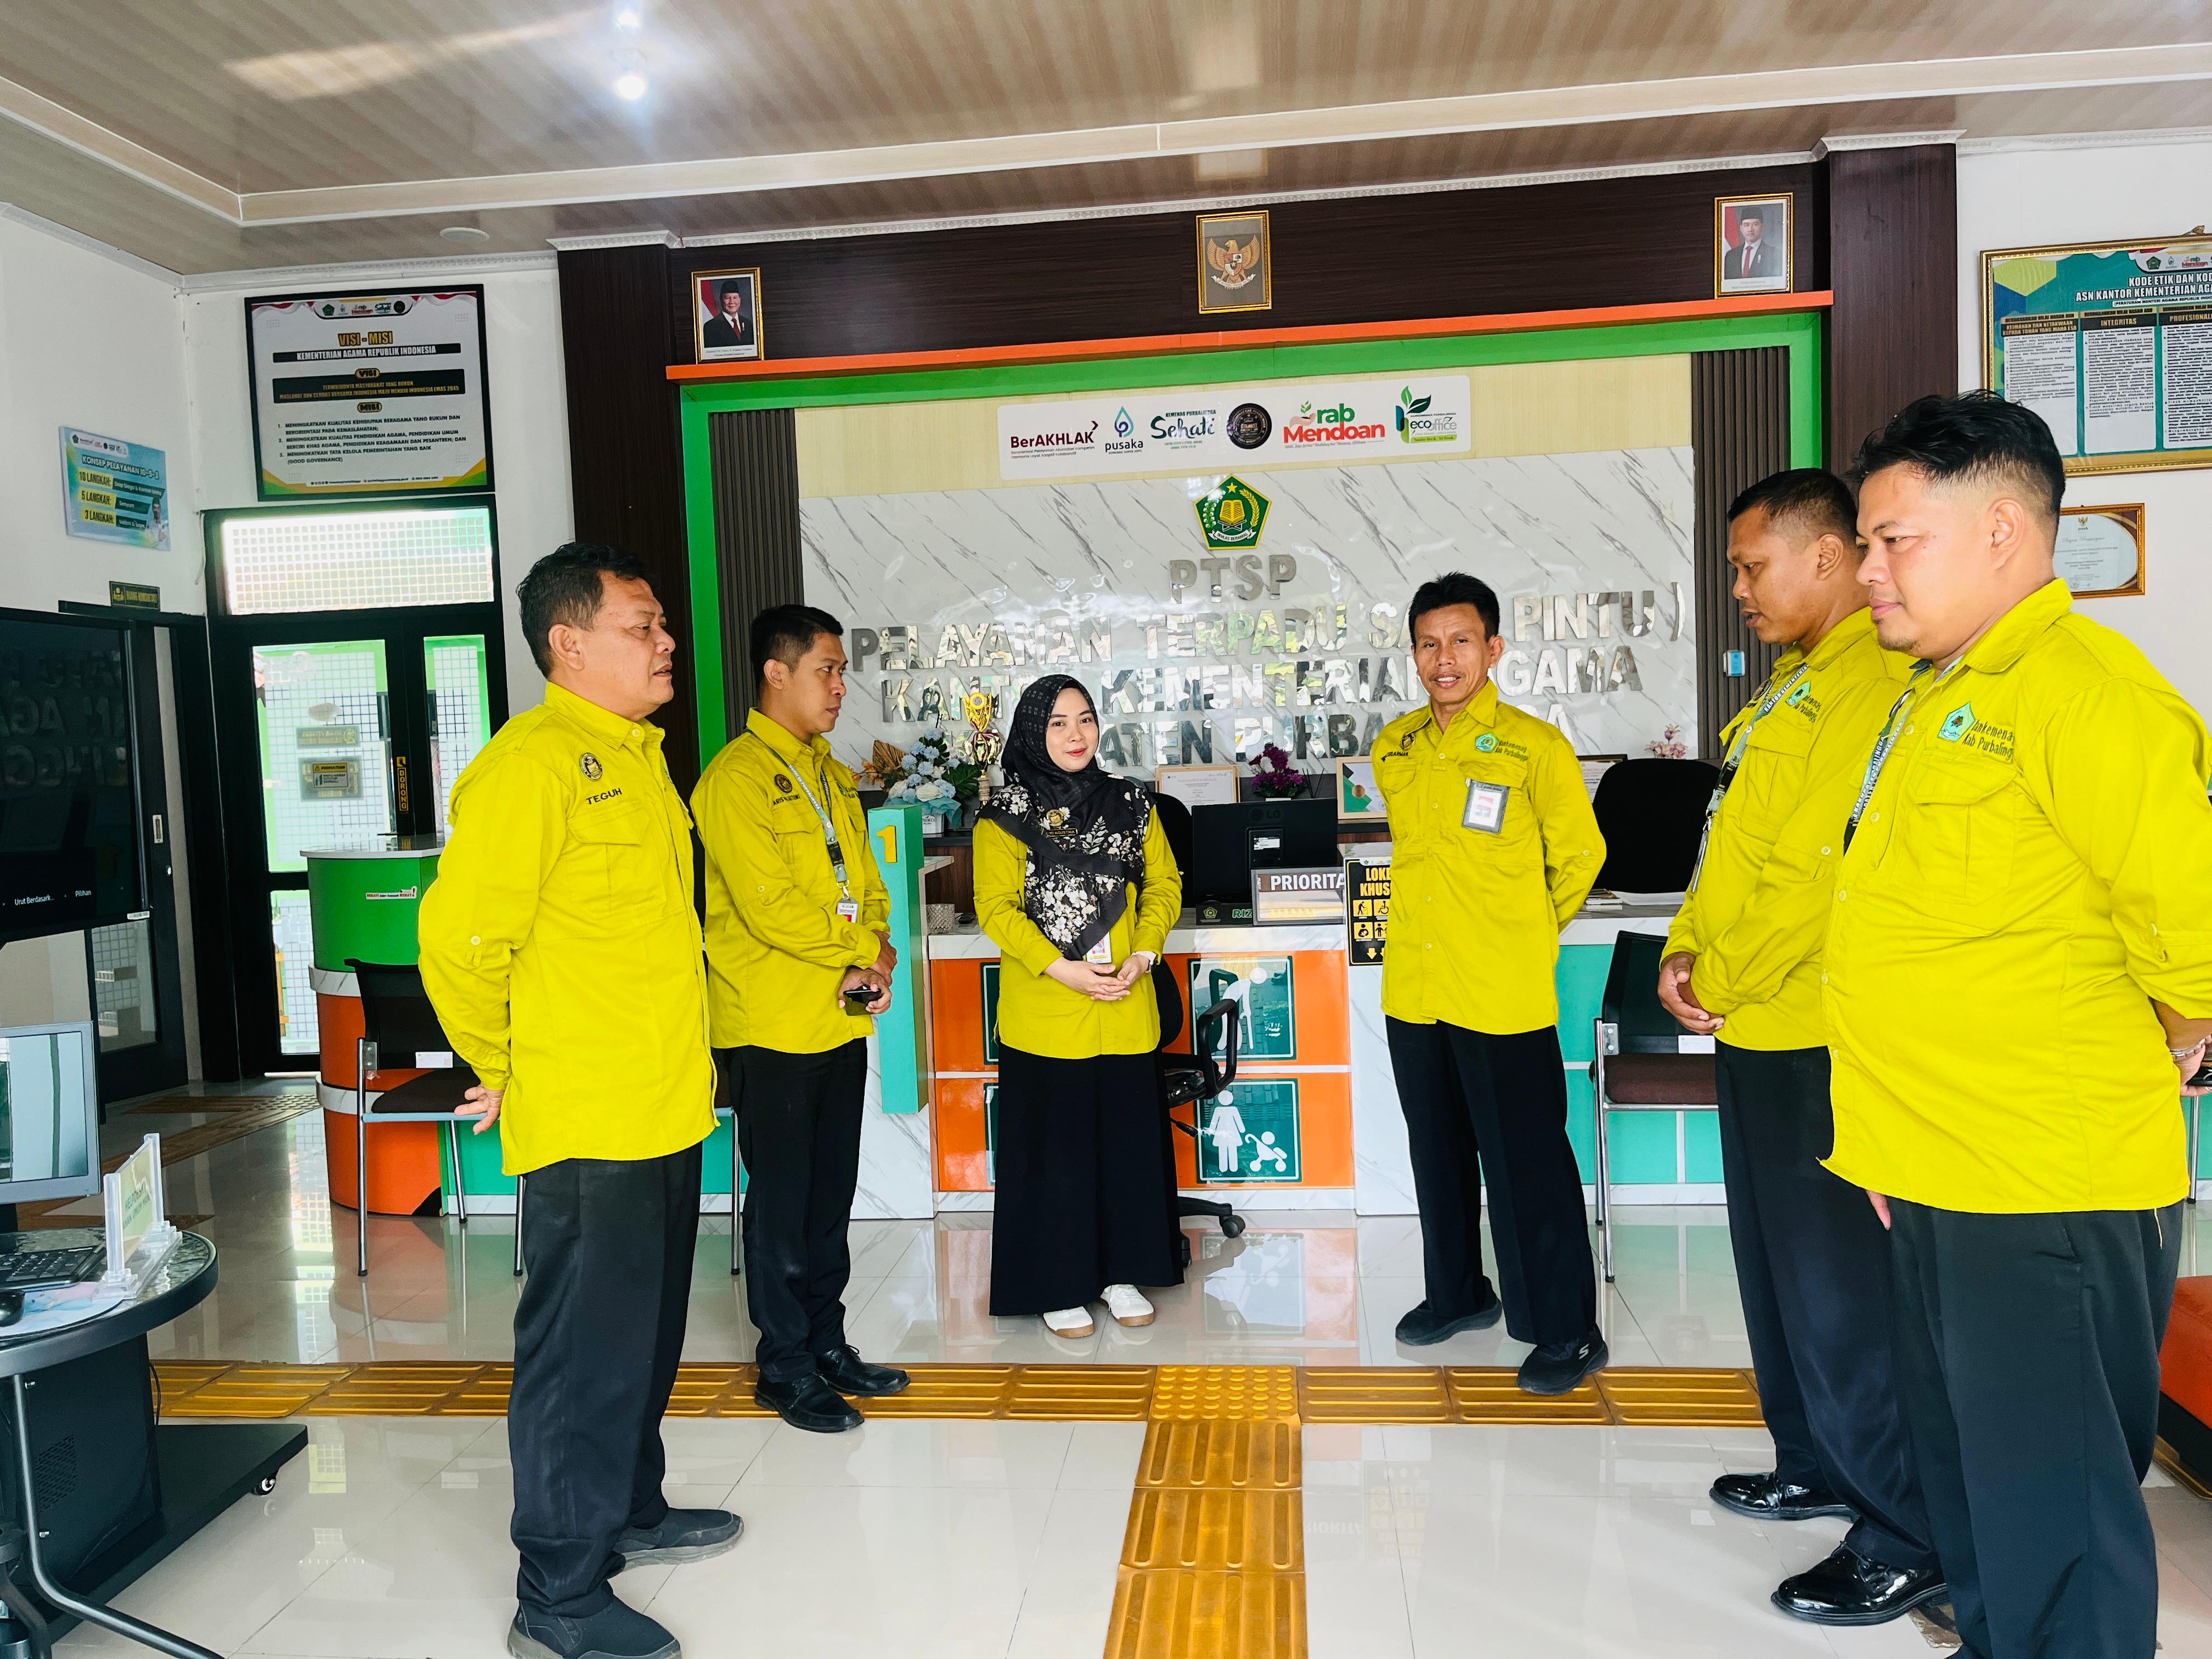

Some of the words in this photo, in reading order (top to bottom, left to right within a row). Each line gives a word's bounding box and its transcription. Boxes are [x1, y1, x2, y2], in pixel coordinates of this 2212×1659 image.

[2129, 276, 2152, 287] KODE
[2154, 275, 2175, 285] ETIK
[2176, 274, 2194, 284] DAN
[2196, 273, 2212, 283] KOD
[2075, 291, 2094, 302] ASN
[2096, 289, 2132, 300] KANTOR
[2134, 284, 2196, 298] KEMENTERIAN
[2101, 318, 2137, 326] INTEGRITAS
[338, 332, 360, 347] VISI
[368, 331, 393, 345] MISI
[297, 350, 342, 360] KEMENTERIAN
[343, 349, 367, 358] AGAMA
[368, 347, 399, 357] REPUBLIK
[400, 346, 436, 355] INDONESIA
[1150, 415, 1216, 439] Sehati
[1283, 421, 1385, 443] Mendoan
[1011, 430, 1094, 448] BerAKHLAK
[1105, 438, 1143, 453] pusaka
[82, 455, 106, 467] KONSEP
[107, 461, 140, 475] PELAYANAN
[79, 471, 87, 481] 10
[81, 491, 86, 499] 5
[85, 510, 89, 519] 3
[1217, 533, 1230, 541] IKHLAS
[1231, 533, 1249, 541] BERAMAL
[1170, 554, 1296, 604] PTSP
[851, 617, 1112, 672] PELAYANAN
[1135, 605, 1347, 659] TERPADU
[1513, 590, 1655, 642] PINTU
[1101, 656, 1431, 714] KEMENTERIAN
[1487, 646, 1644, 697] GAMA
[1763, 692, 1783, 713] KANTOR
[1781, 664, 1809, 694] KEMENTERIA
[399, 770, 407, 809] DORONG
[585, 788, 623, 805] TEGUH
[1266, 808, 1281, 819] LG
[877, 825, 897, 864] 1
[1271, 873, 1344, 891] PRIORITA
[1360, 882, 1391, 897] KHUS
